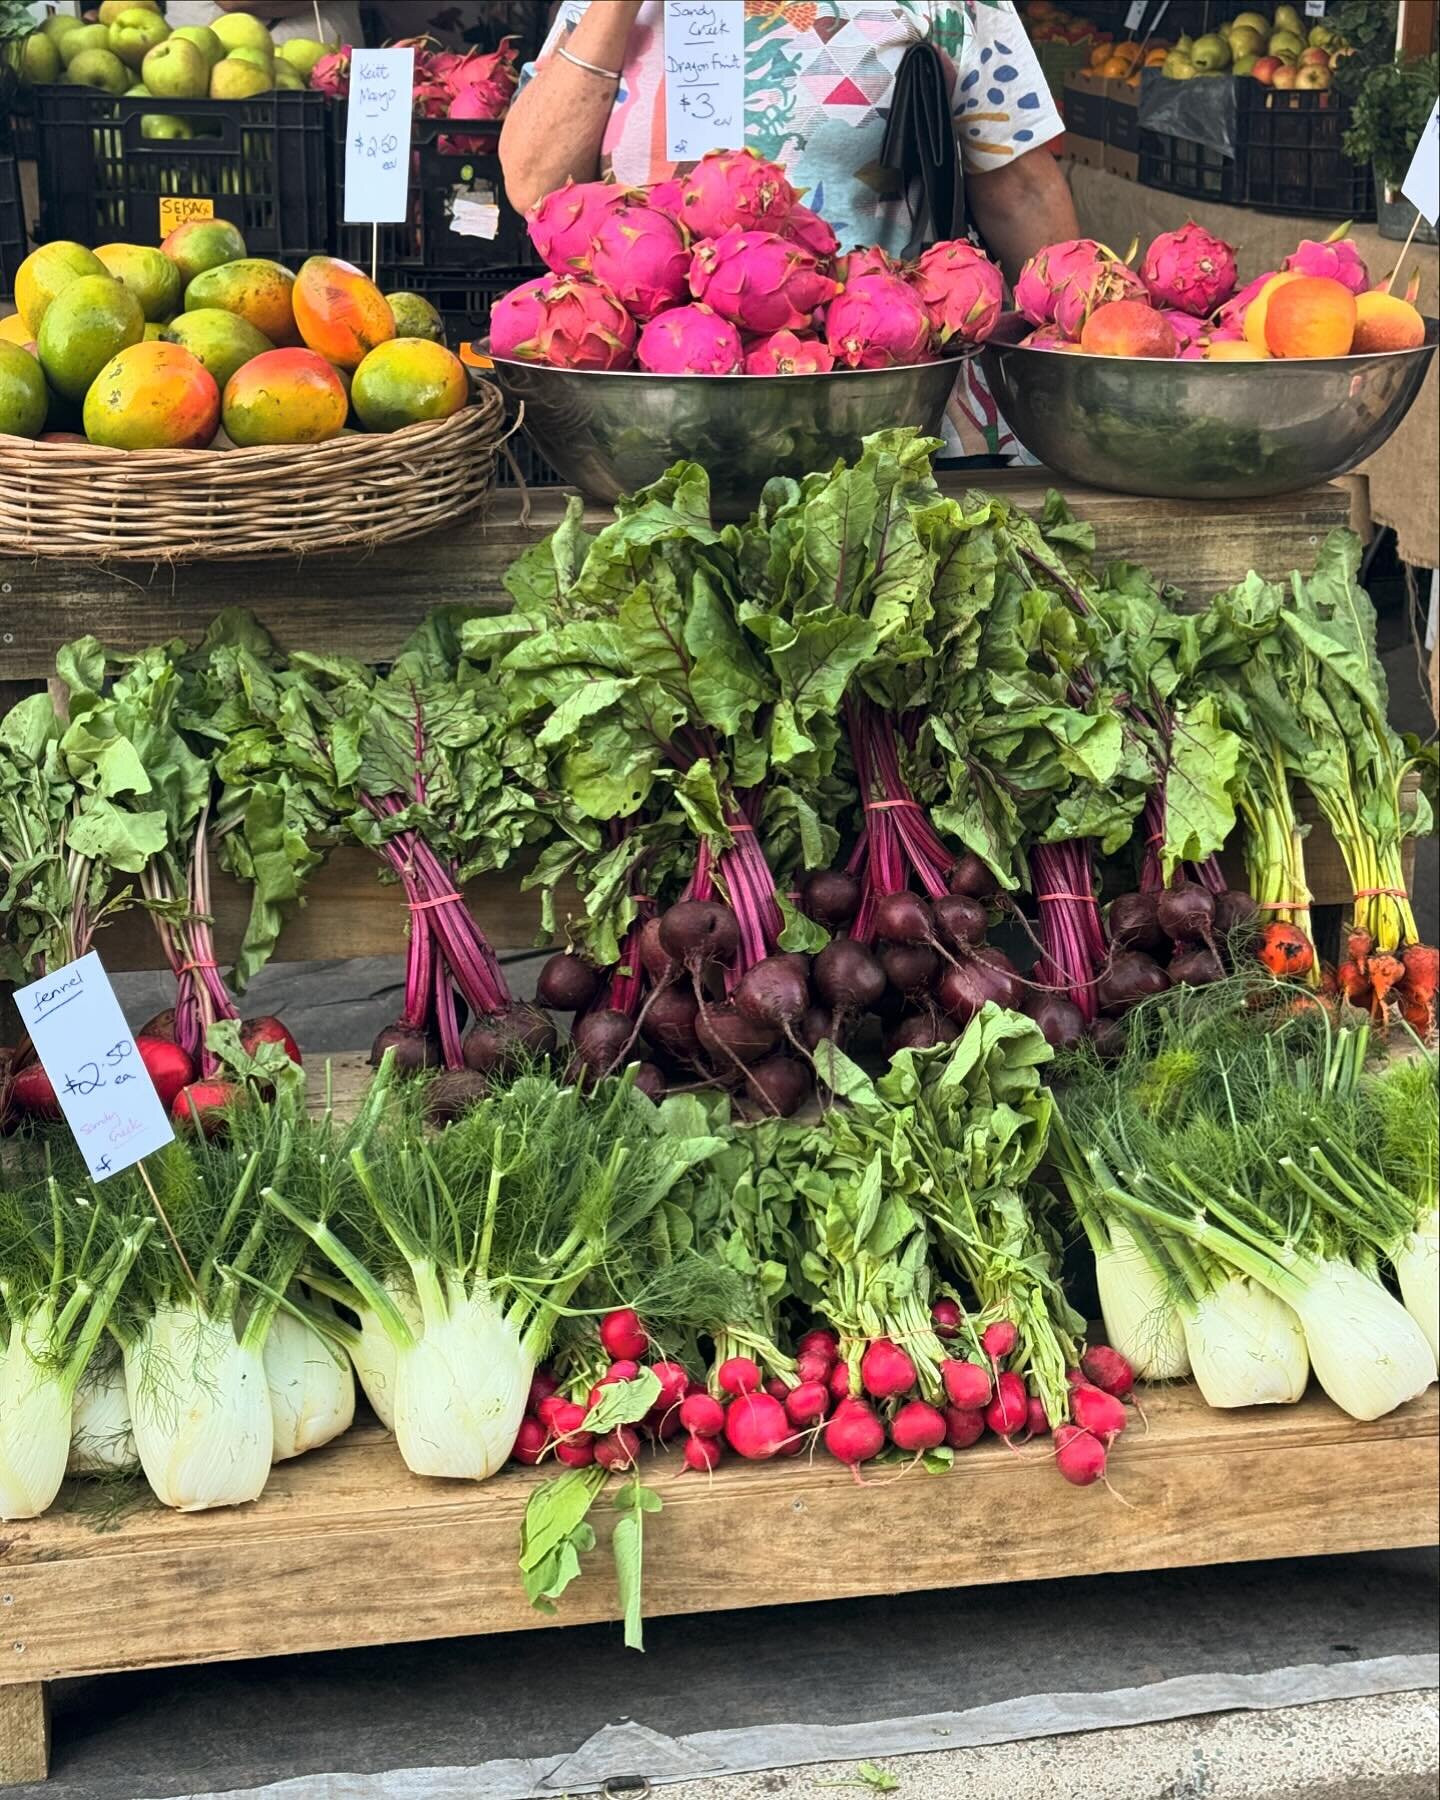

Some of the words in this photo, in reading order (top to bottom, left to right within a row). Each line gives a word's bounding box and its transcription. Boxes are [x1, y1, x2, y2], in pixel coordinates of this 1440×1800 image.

[669, 2, 716, 27] Sandy
[688, 18, 730, 36] Creek
[679, 92, 716, 119] $3
[33, 970, 84, 1012] fennel
[62, 1039, 133, 1095] $2.50
[114, 1073, 137, 1086] ea
[80, 1111, 121, 1135] Sandy
[108, 1118, 142, 1143] Creek
